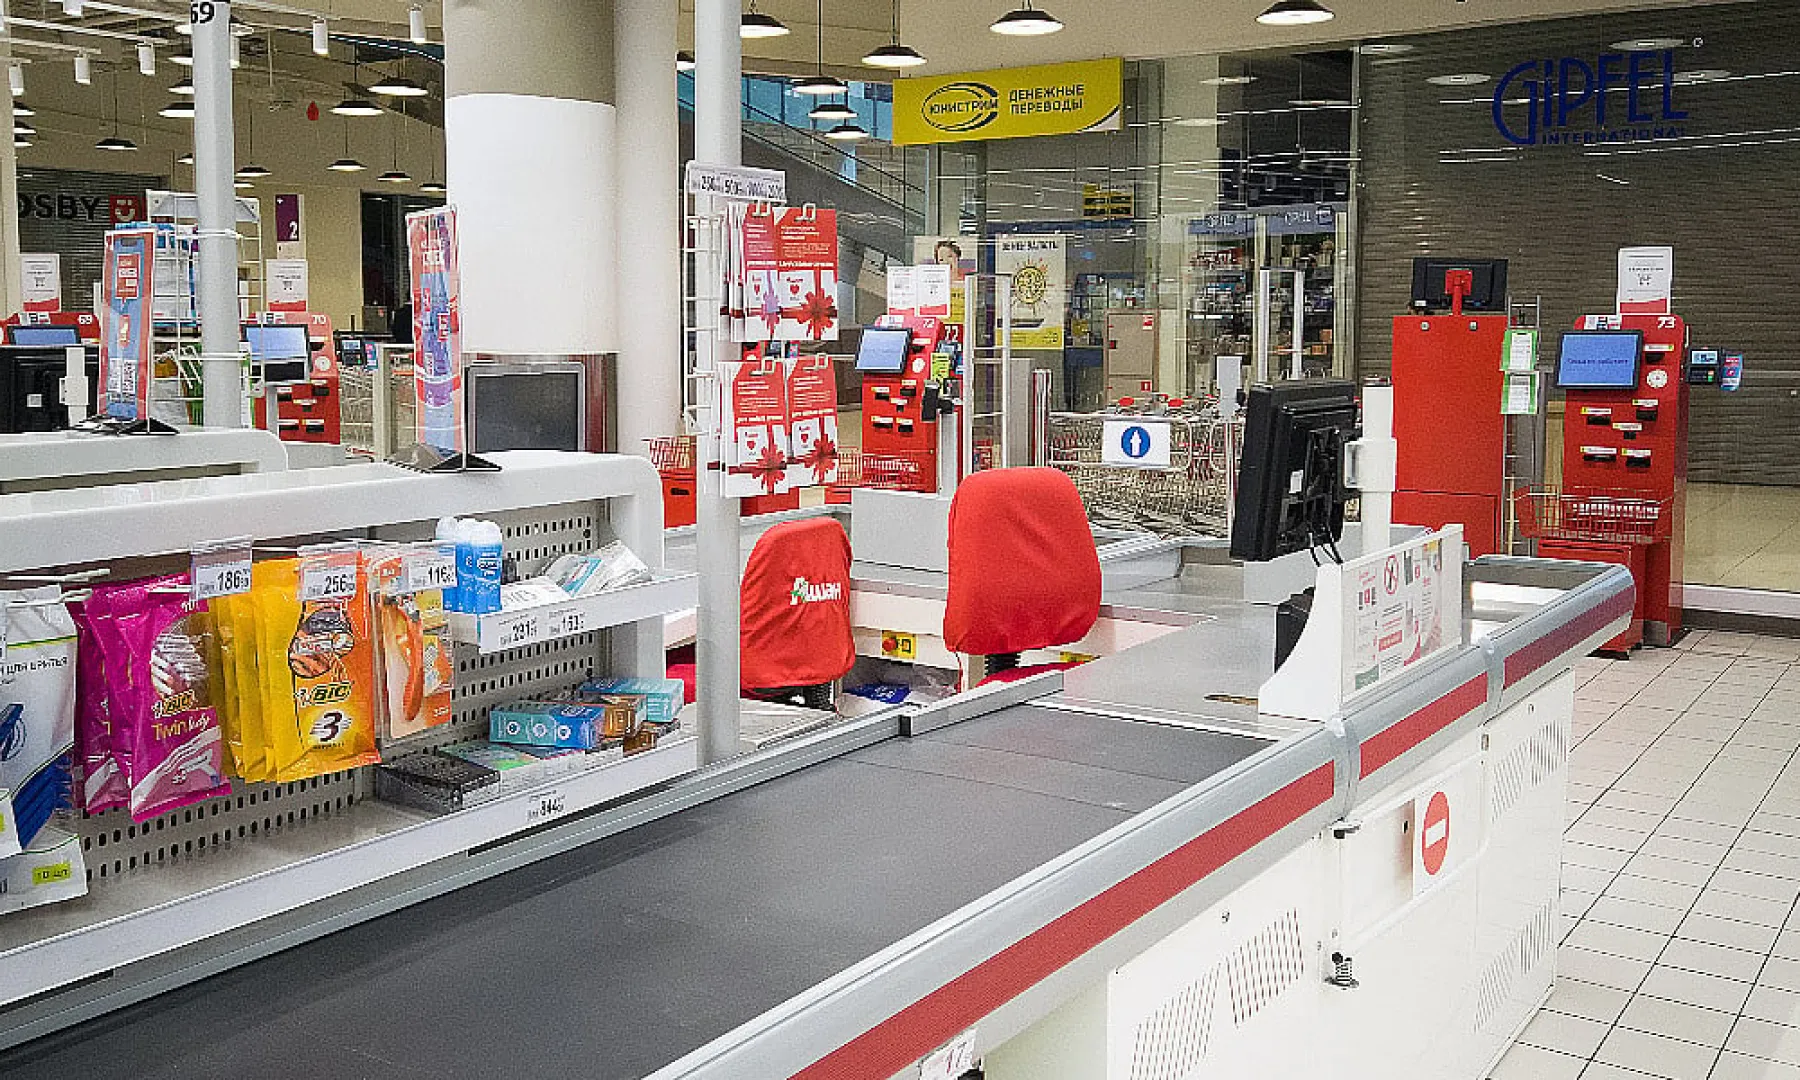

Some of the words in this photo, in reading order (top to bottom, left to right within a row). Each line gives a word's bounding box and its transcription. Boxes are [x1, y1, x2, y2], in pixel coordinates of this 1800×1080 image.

[1009, 84, 1084, 102] ДЕНЕЖНЫЕ
[930, 98, 998, 115] ЮНИСТРИМ
[1011, 98, 1083, 115] ПЕРЕВОДЫ
[289, 221, 298, 239] 2
[1657, 317, 1676, 329] 73
[217, 570, 242, 591] 186
[324, 574, 347, 595] 256
[428, 565, 447, 585] 116
[151, 720, 188, 741] Twin
[320, 711, 343, 742] 3
